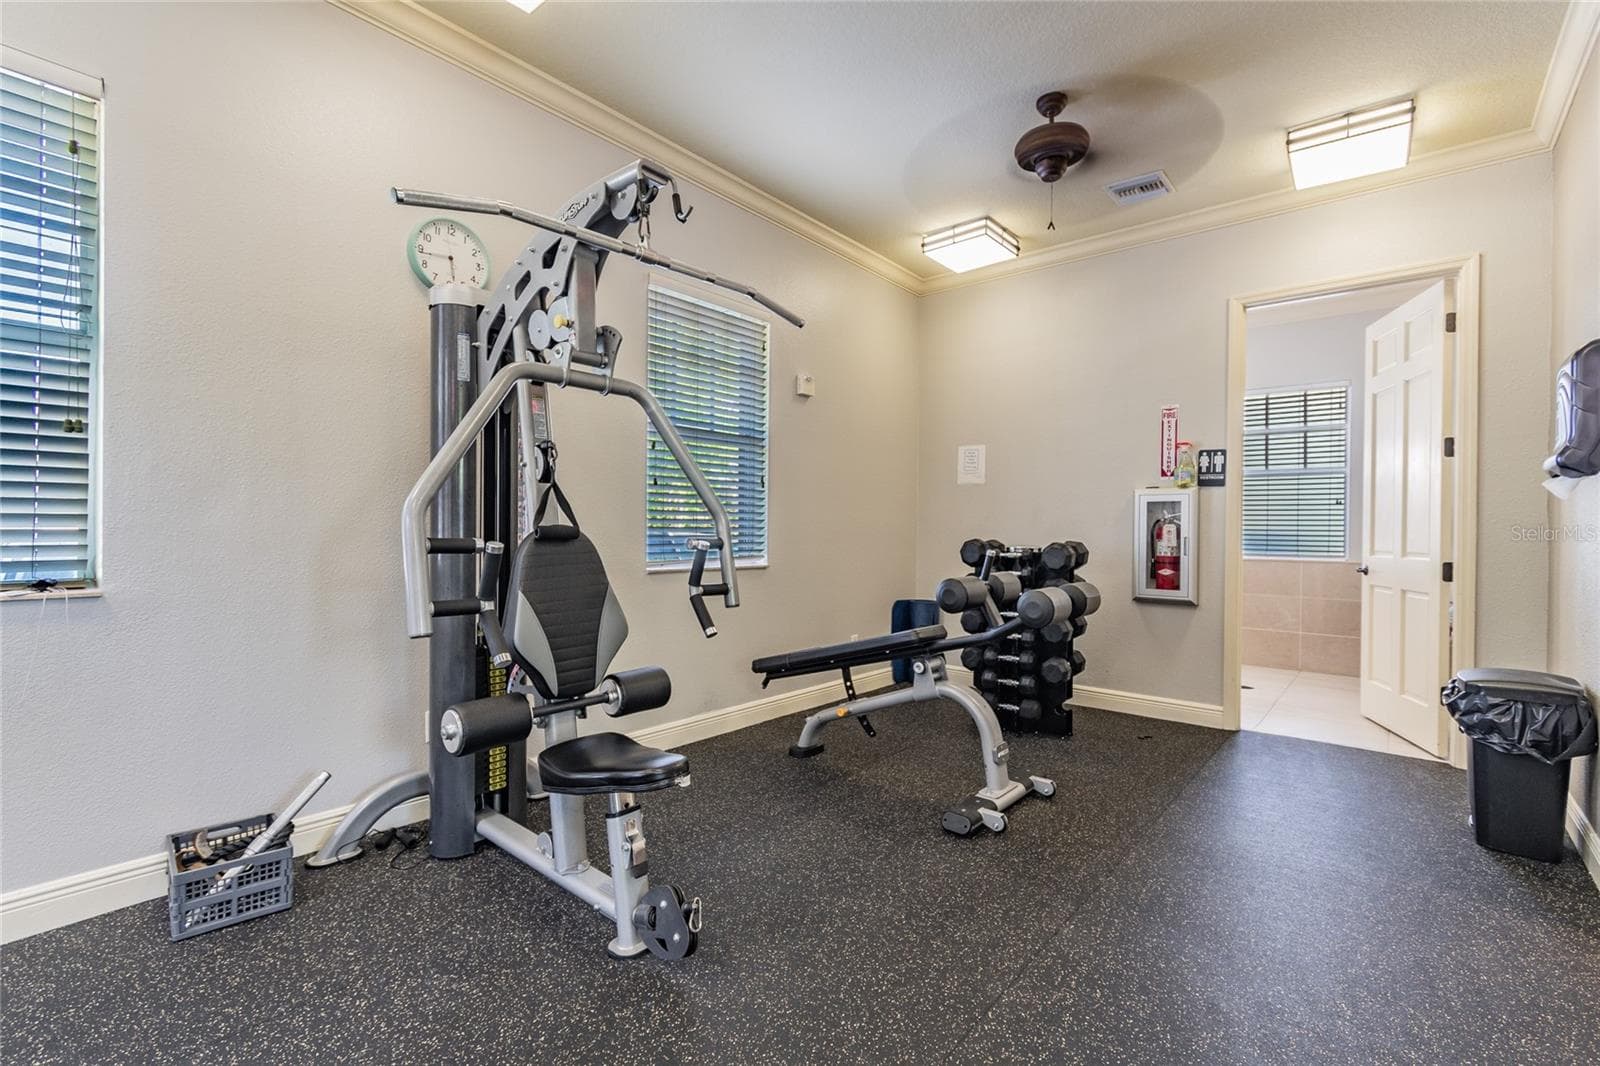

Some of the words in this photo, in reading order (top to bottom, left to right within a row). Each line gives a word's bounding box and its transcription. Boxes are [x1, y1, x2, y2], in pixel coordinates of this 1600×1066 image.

[435, 226, 441, 236] 11
[447, 226, 456, 237] 12
[423, 232, 432, 243] 10
[417, 244, 424, 253] 9
[472, 249, 477, 257] 2
[421, 260, 428, 269] 8
[475, 263, 481, 272] 3
[432, 272, 439, 281] 7
